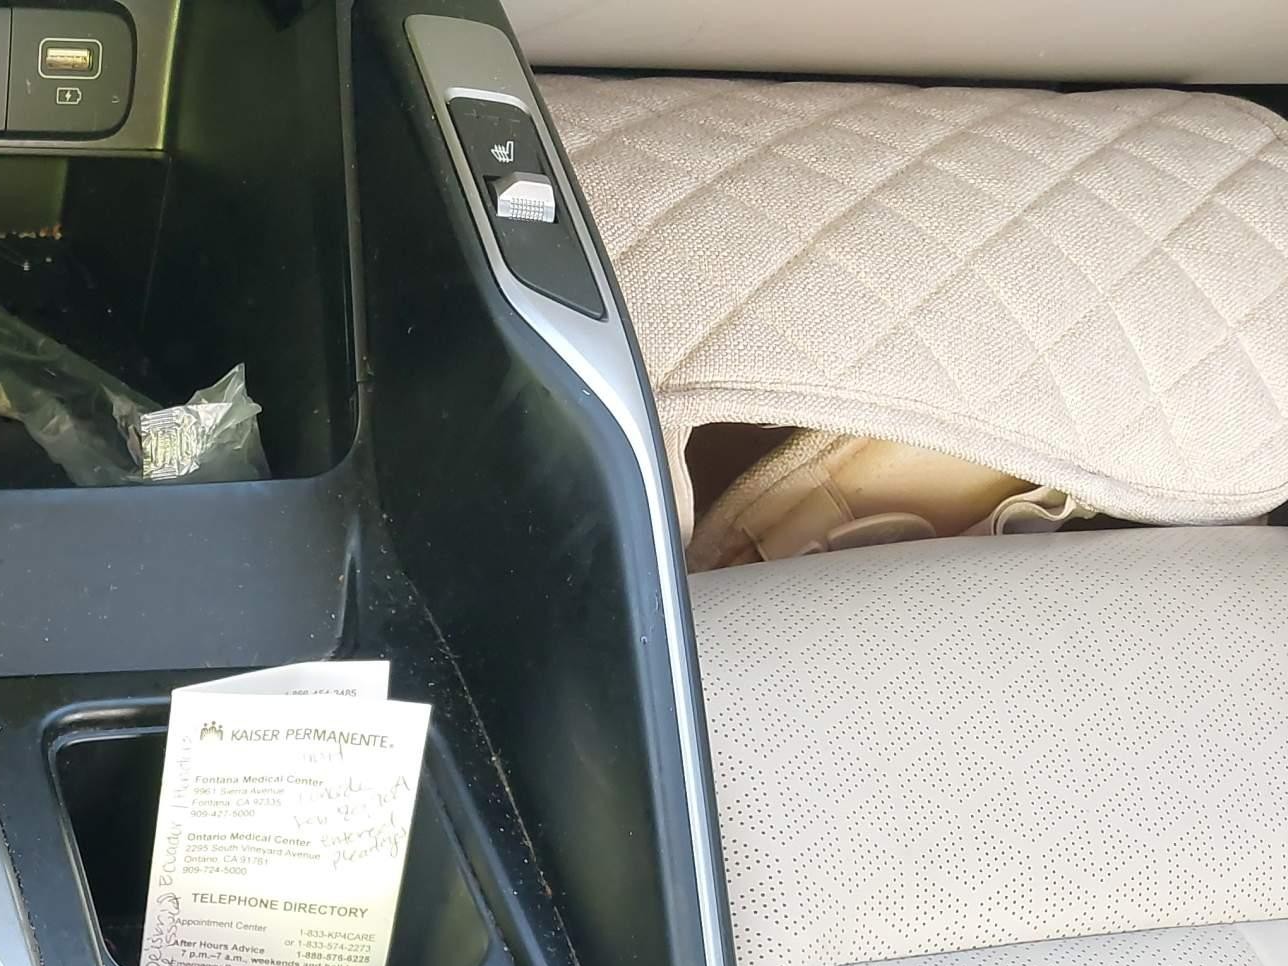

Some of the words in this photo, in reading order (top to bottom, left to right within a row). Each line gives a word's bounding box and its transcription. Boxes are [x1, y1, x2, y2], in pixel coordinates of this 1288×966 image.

[230, 729, 280, 741] KAISER
[195, 775, 239, 784] Fontana
[242, 775, 283, 784] Medical
[286, 775, 324, 787] Center
[235, 798, 250, 806] CA
[187, 832, 227, 841] Ontario
[229, 832, 271, 843] Medical
[274, 835, 312, 847] Center
[185, 844, 209, 853] 2295
[212, 844, 238, 852] South
[241, 844, 283, 856] Vineyard
[286, 850, 321, 861] Avenue
[223, 855, 238, 863] CA
[191, 892, 280, 911] TELEPHONE
[283, 900, 369, 919] DIRECTORY
[175, 918, 233, 929] Appointment
[235, 921, 267, 932] Center
[172, 939, 197, 948] After
[199, 941, 229, 950] Hours
[231, 944, 265, 954] Advice
[181, 949, 187, 958] 7
